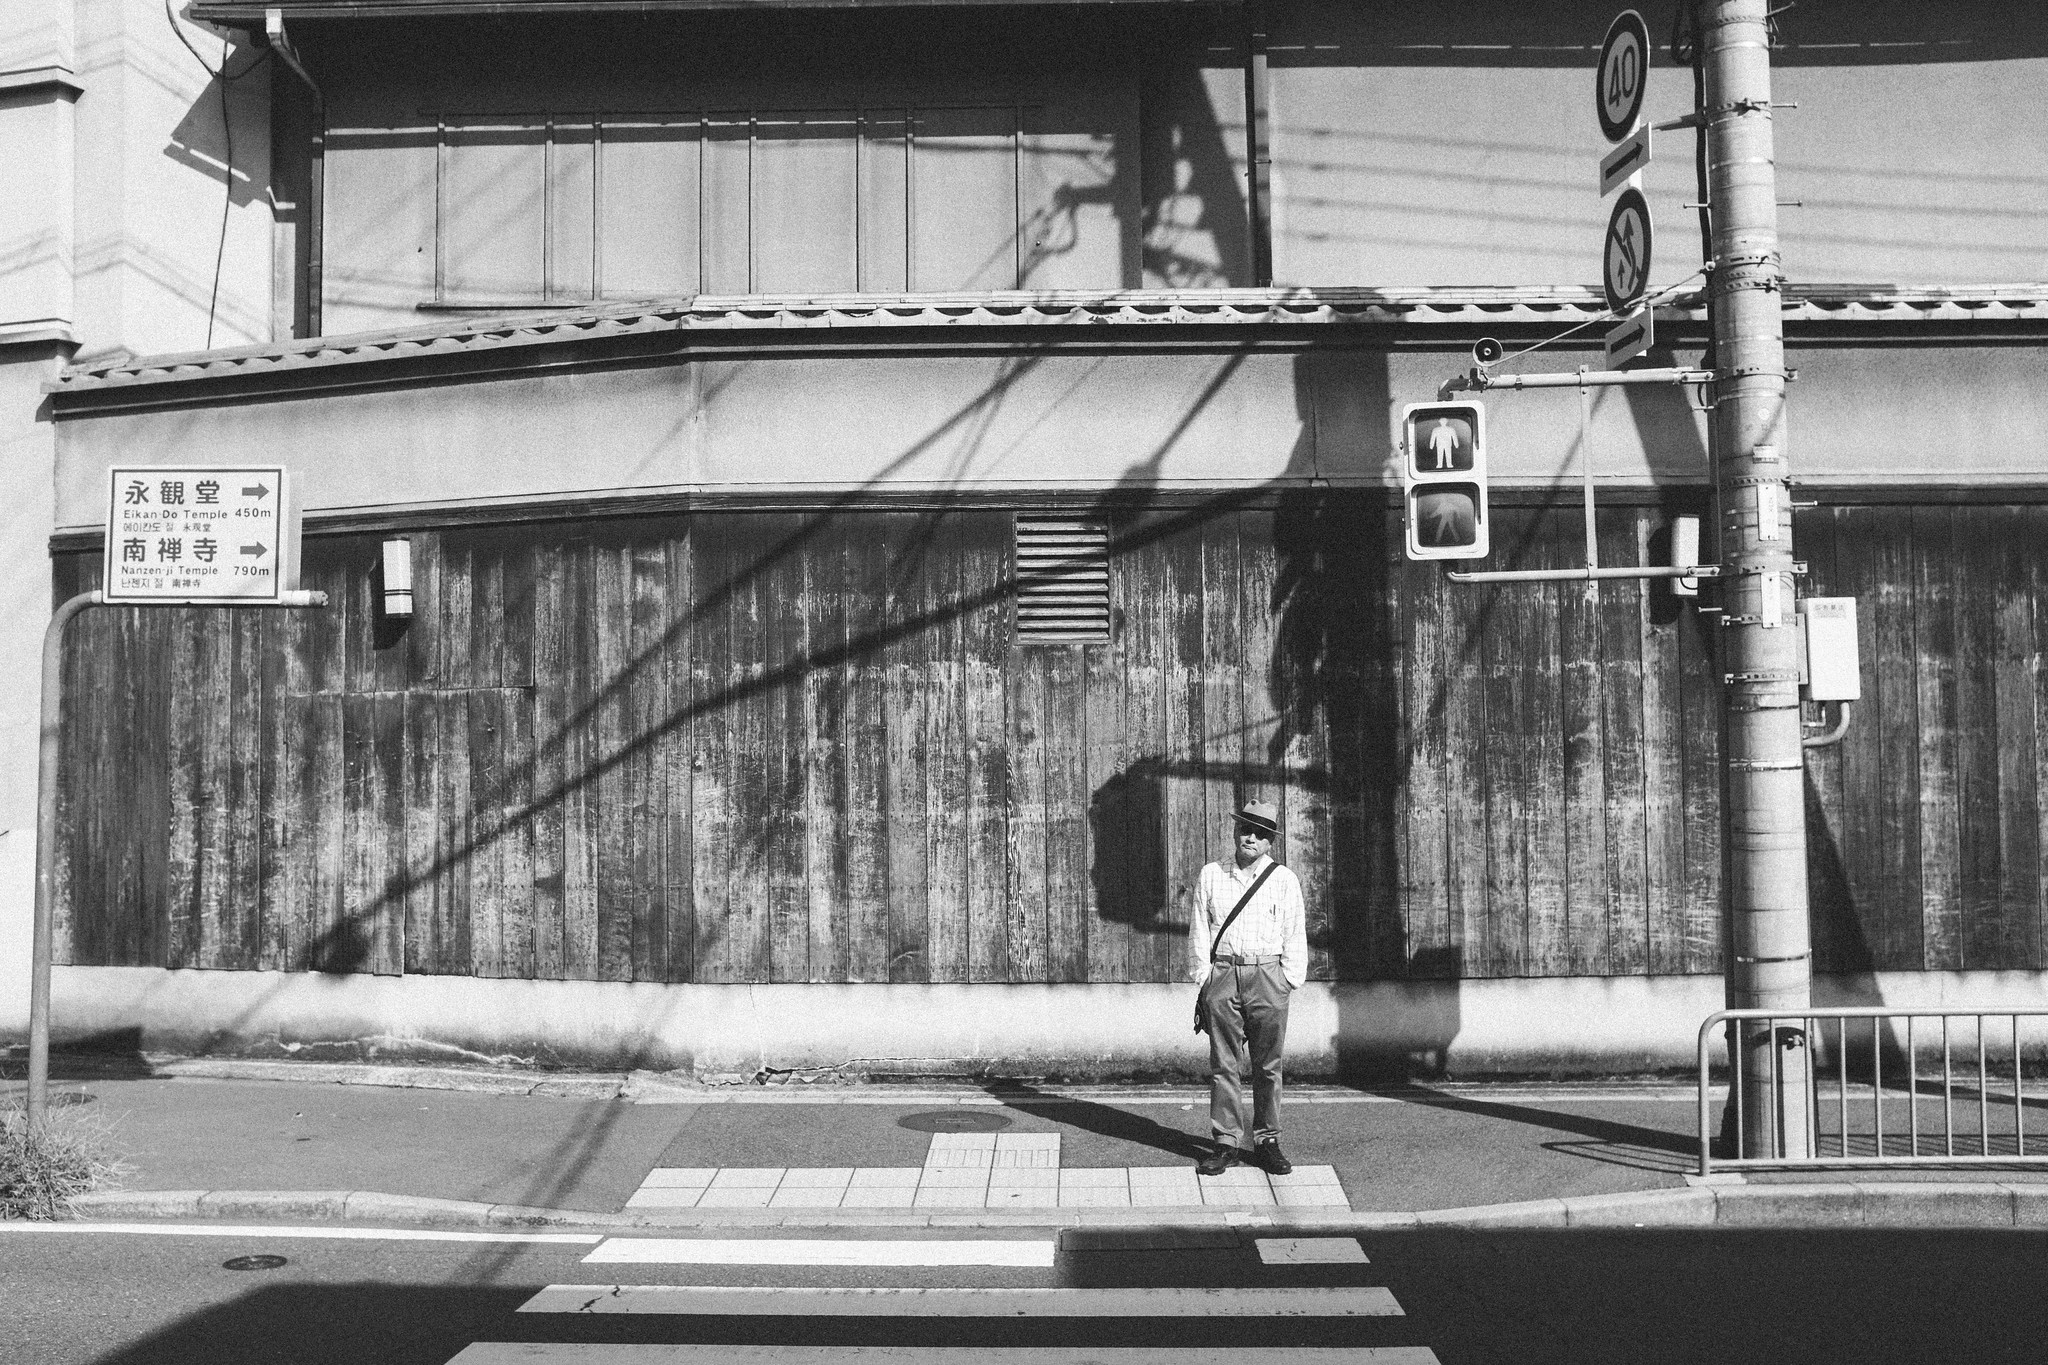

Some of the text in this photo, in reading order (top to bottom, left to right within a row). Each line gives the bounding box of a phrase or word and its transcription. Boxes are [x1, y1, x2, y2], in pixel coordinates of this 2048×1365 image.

[1608, 44, 1636, 108] 40
[125, 480, 220, 505] 永観堂
[184, 509, 228, 520] Temple
[235, 507, 271, 518] 450m
[123, 537, 218, 563] 南禅寺
[121, 566, 218, 577] Nanzen-ji Temple
[234, 566, 270, 576] 790m
